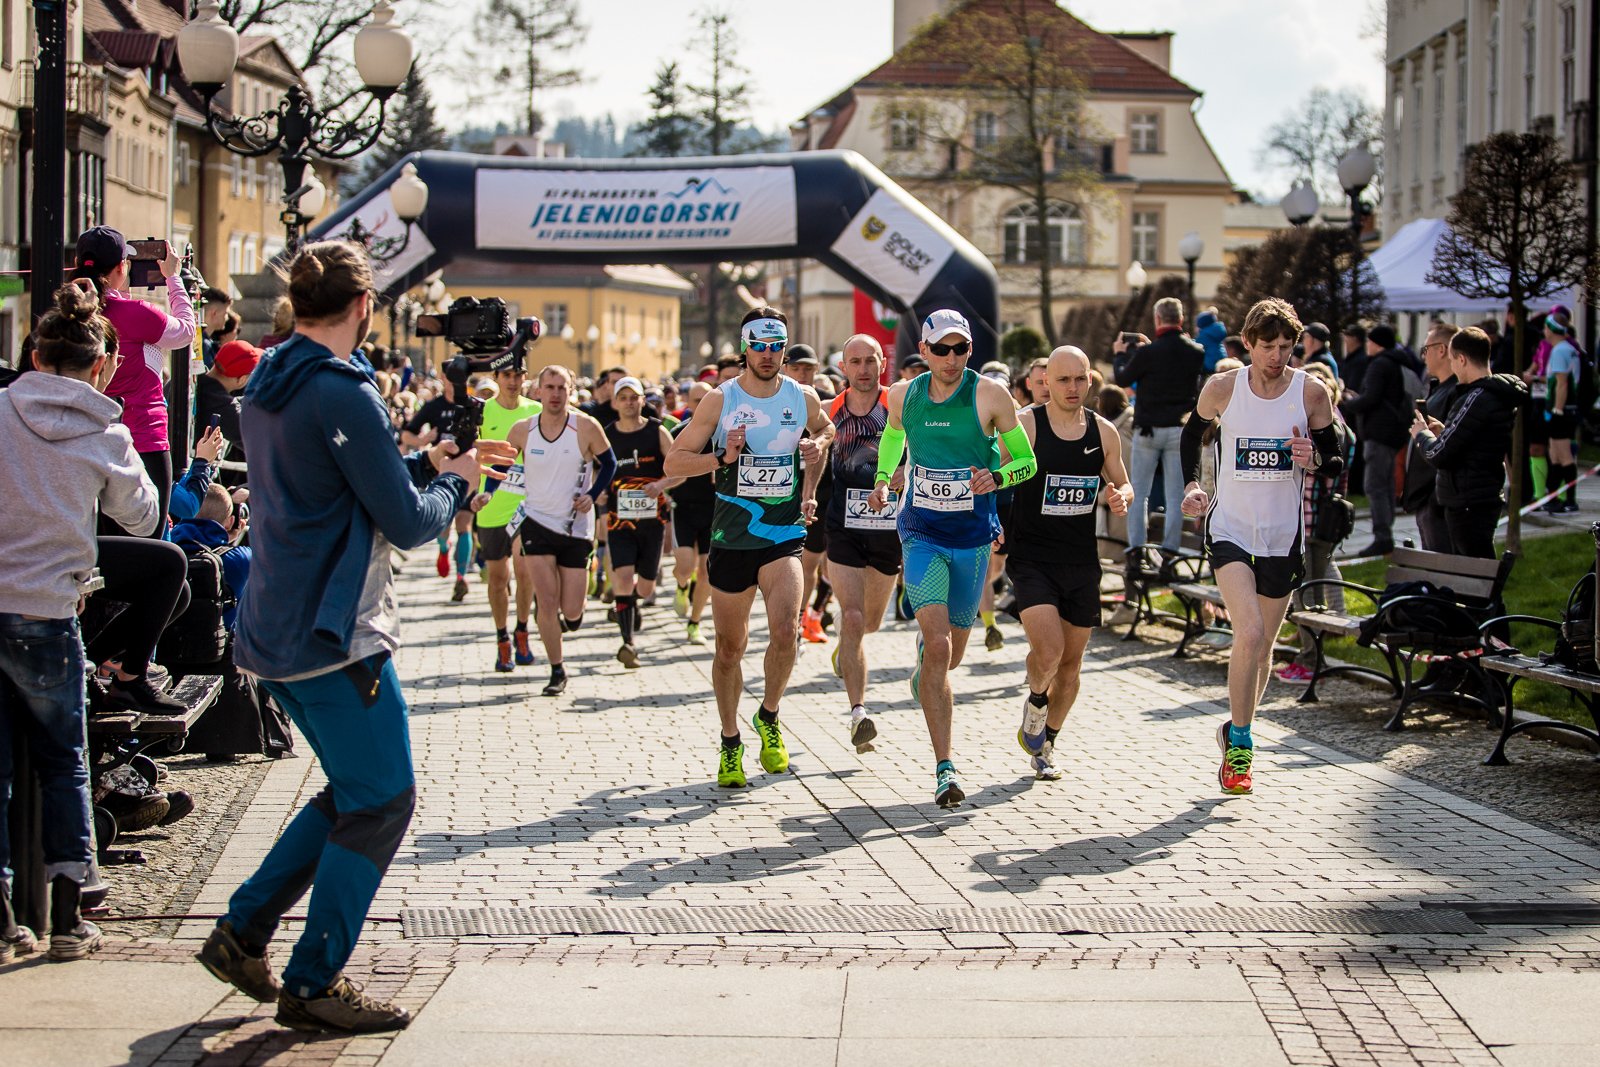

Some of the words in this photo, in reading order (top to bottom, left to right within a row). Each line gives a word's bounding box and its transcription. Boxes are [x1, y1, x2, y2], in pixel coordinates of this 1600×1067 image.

[531, 201, 742, 228] JELENIOGÓRSKI
[490, 351, 514, 369] RONIN
[1248, 450, 1279, 467] 899
[757, 468, 777, 482] 27
[1006, 464, 1031, 483] XTECH
[931, 483, 951, 497] 66
[1057, 488, 1085, 503] 919
[628, 499, 647, 508] 186
